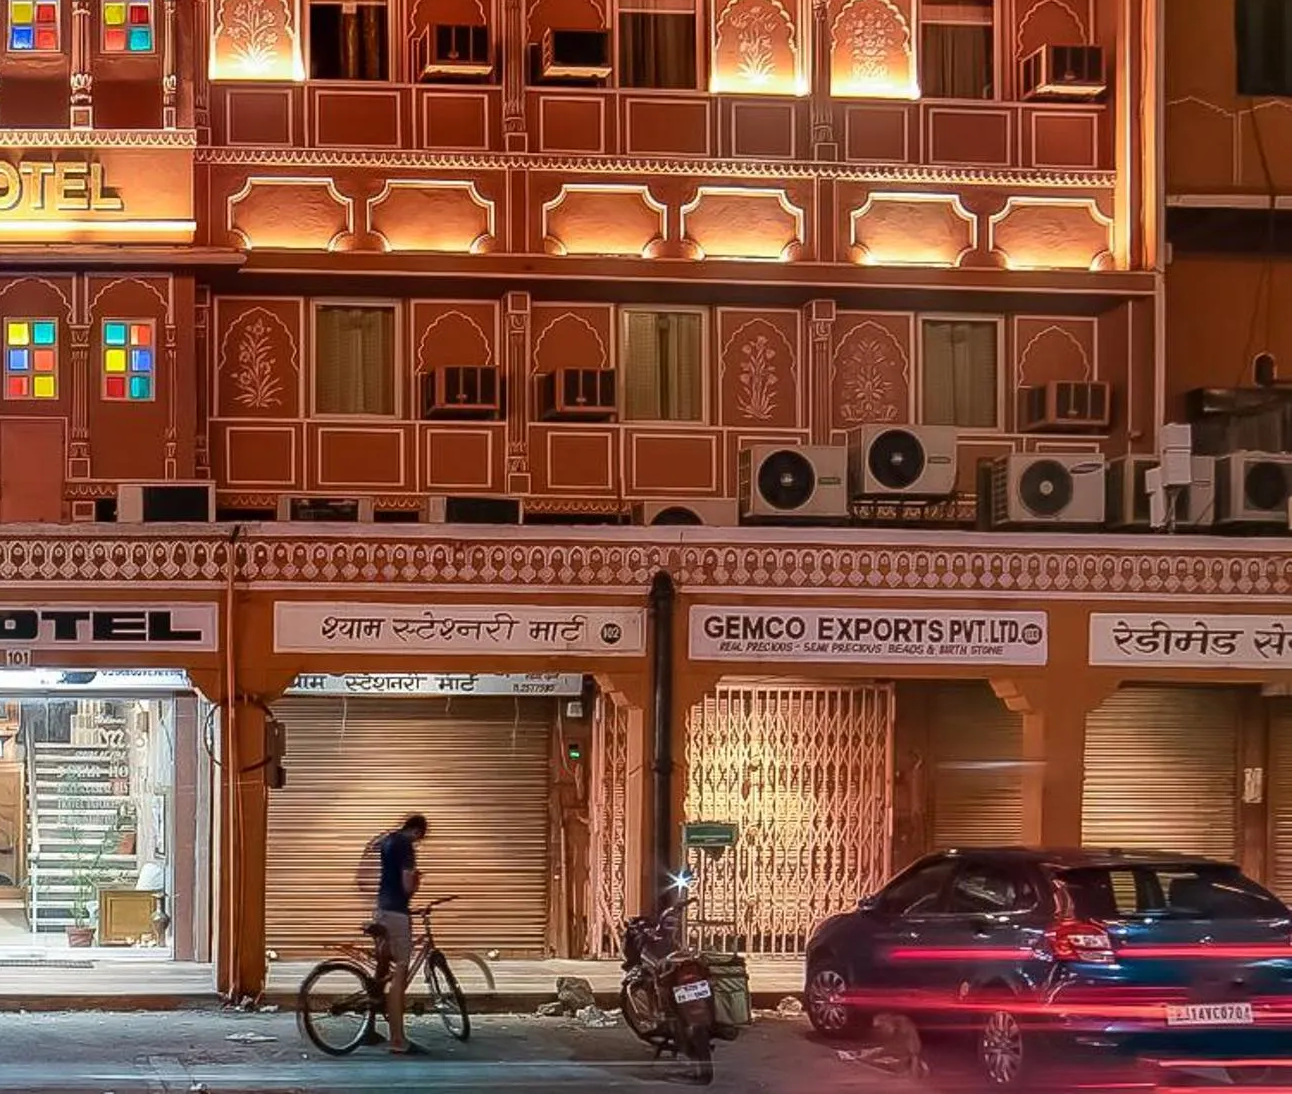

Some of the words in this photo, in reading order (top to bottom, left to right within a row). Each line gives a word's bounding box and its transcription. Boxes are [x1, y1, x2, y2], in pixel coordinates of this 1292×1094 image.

[321, 616, 385, 641] श्याम
[529, 614, 589, 643] मार्ट
[704, 616, 806, 641] GEMCO
[817, 617, 944, 644] EXPORTS
[1112, 621, 1245, 655] रेडीमेड
[1253, 623, 1292, 658] से
[7, 651, 30, 665] 101
[719, 641, 744, 652] REAL
[746, 641, 794, 653] PRECIOUS
[804, 642, 829, 653] SEMI
[831, 643, 883, 654] PRECIOUS
[888, 643, 925, 655] BEADS
[926, 645, 936, 655] &
[938, 644, 968, 655] BIRTH
[971, 644, 1004, 656] STONE
